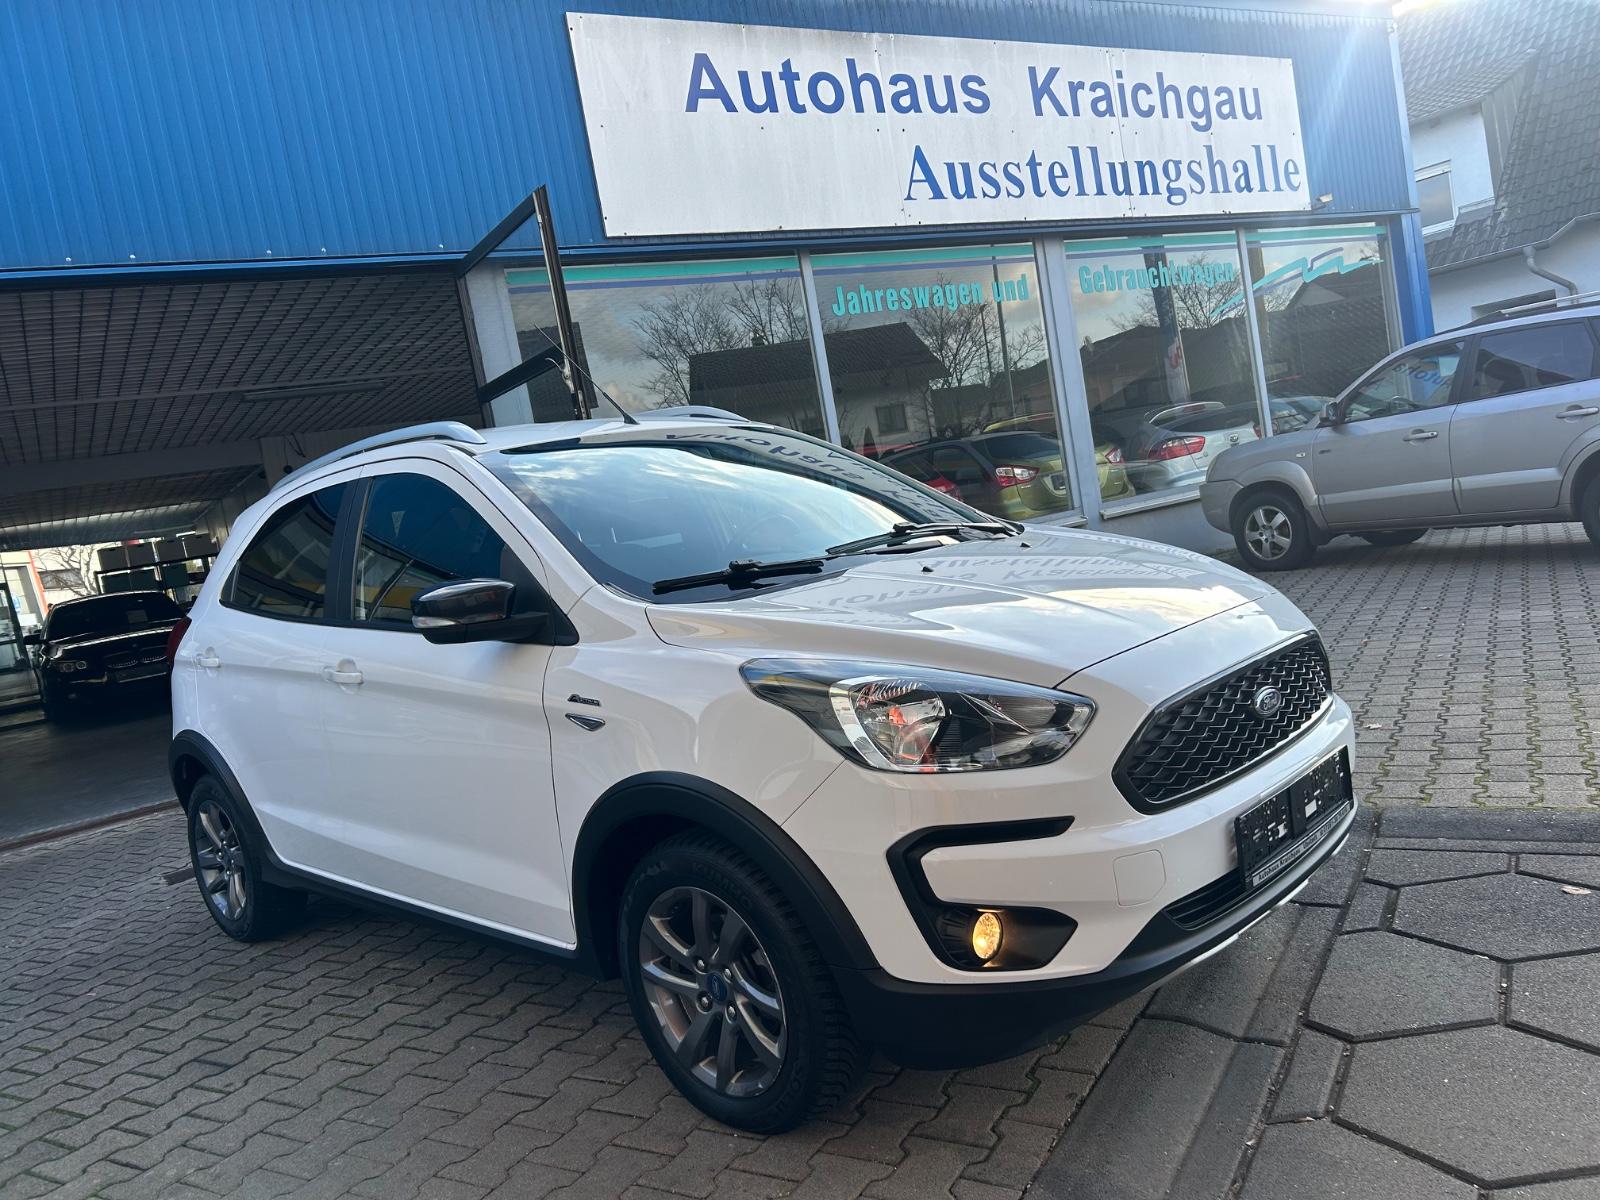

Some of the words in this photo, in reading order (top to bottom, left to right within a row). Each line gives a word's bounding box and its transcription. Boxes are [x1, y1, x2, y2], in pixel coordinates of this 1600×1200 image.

[685, 52, 991, 114] Autohaus
[1027, 65, 1263, 132] Kraichgau
[903, 144, 1301, 206] Ausstellungshalle
[831, 281, 983, 317] Jahreswagen
[992, 272, 1030, 303] und
[1078, 260, 1235, 294] Gebrauchtwagen
